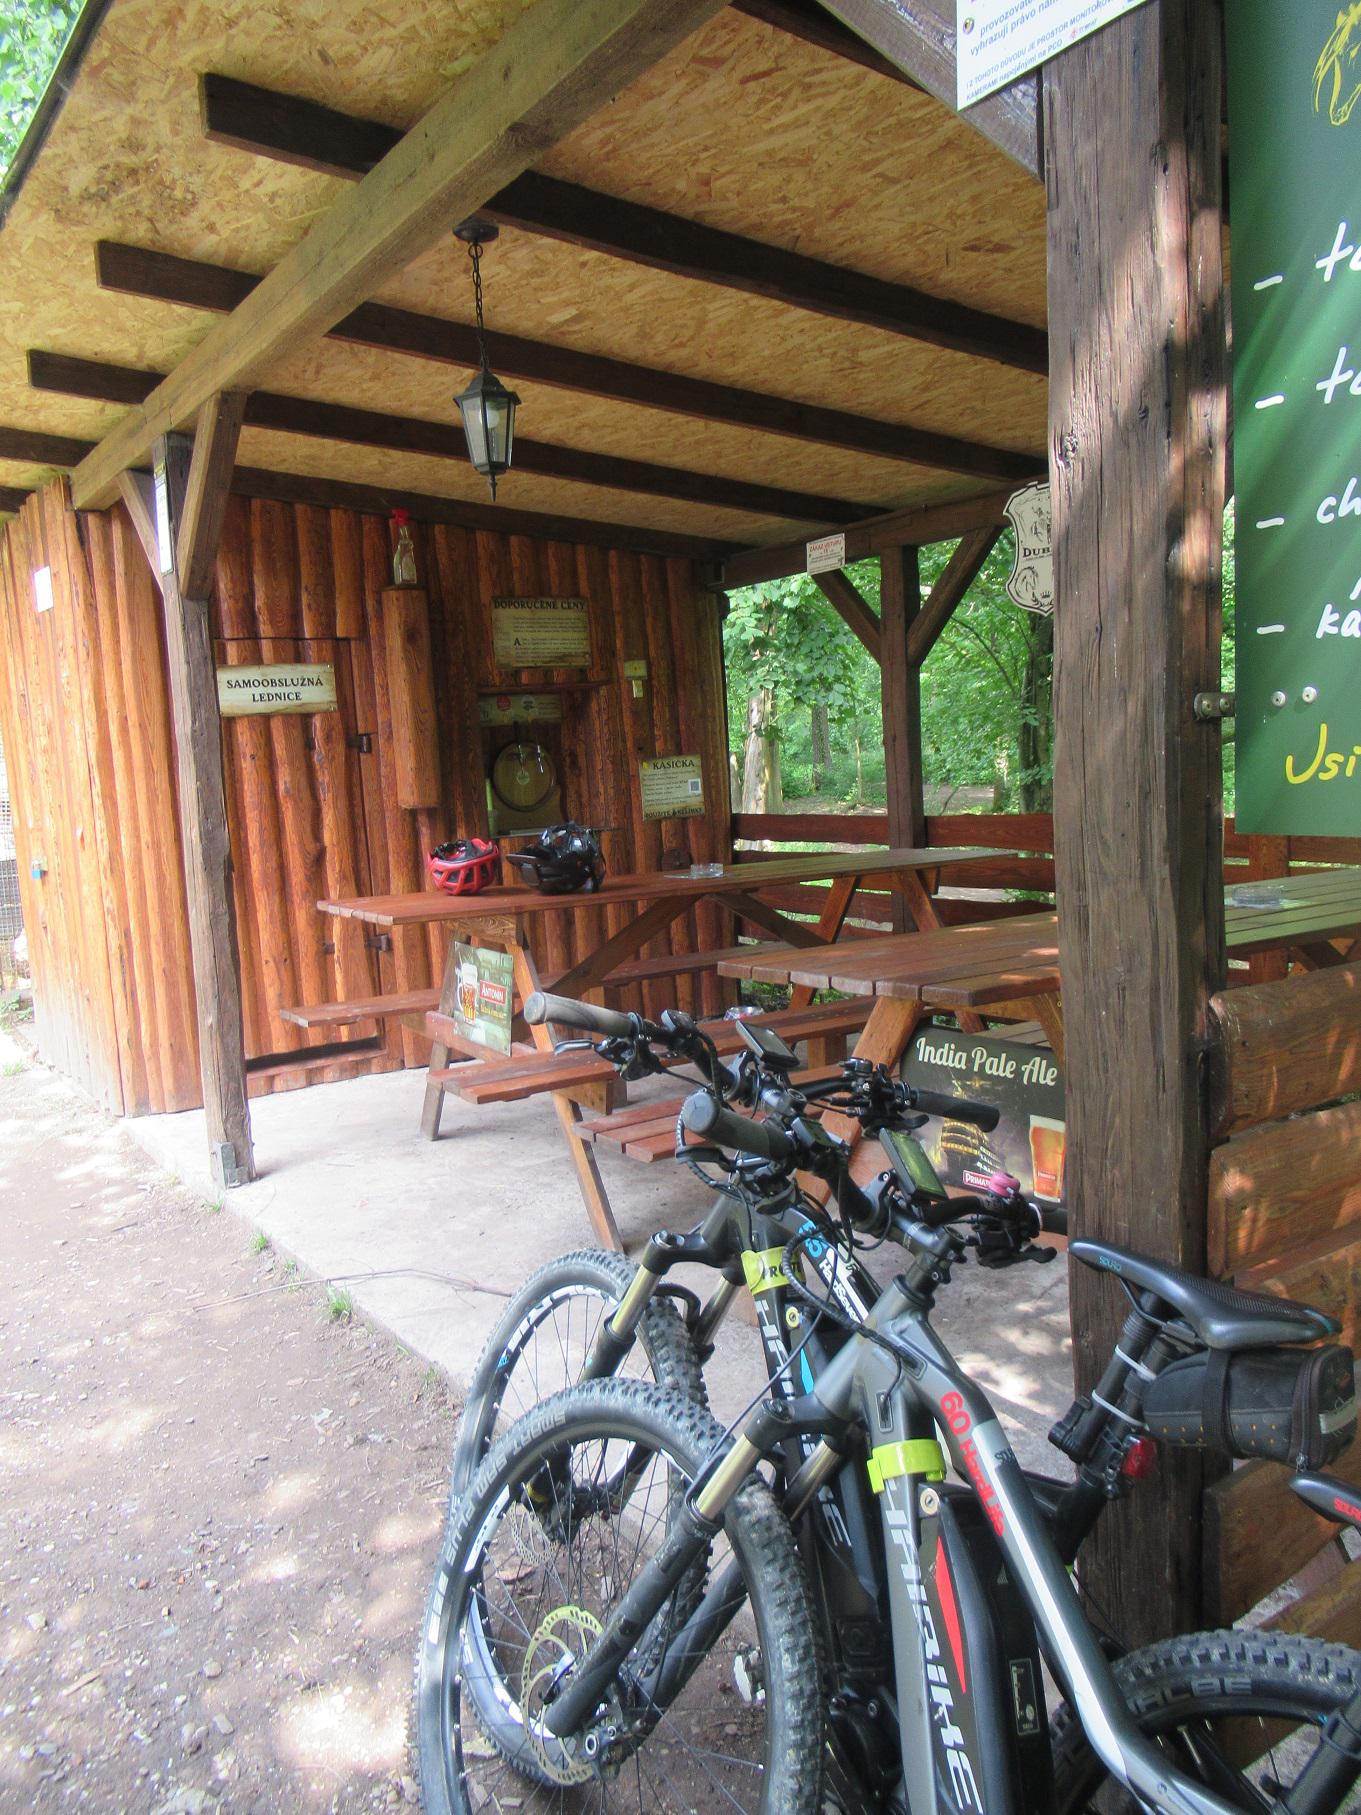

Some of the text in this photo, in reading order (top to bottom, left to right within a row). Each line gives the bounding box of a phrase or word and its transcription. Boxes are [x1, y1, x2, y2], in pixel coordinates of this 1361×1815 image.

[226, 674, 324, 690] SAMOOBSLUŽNÁ
[252, 691, 303, 703] LEDNICE
[916, 1037, 1058, 1086] India Pale Ale
